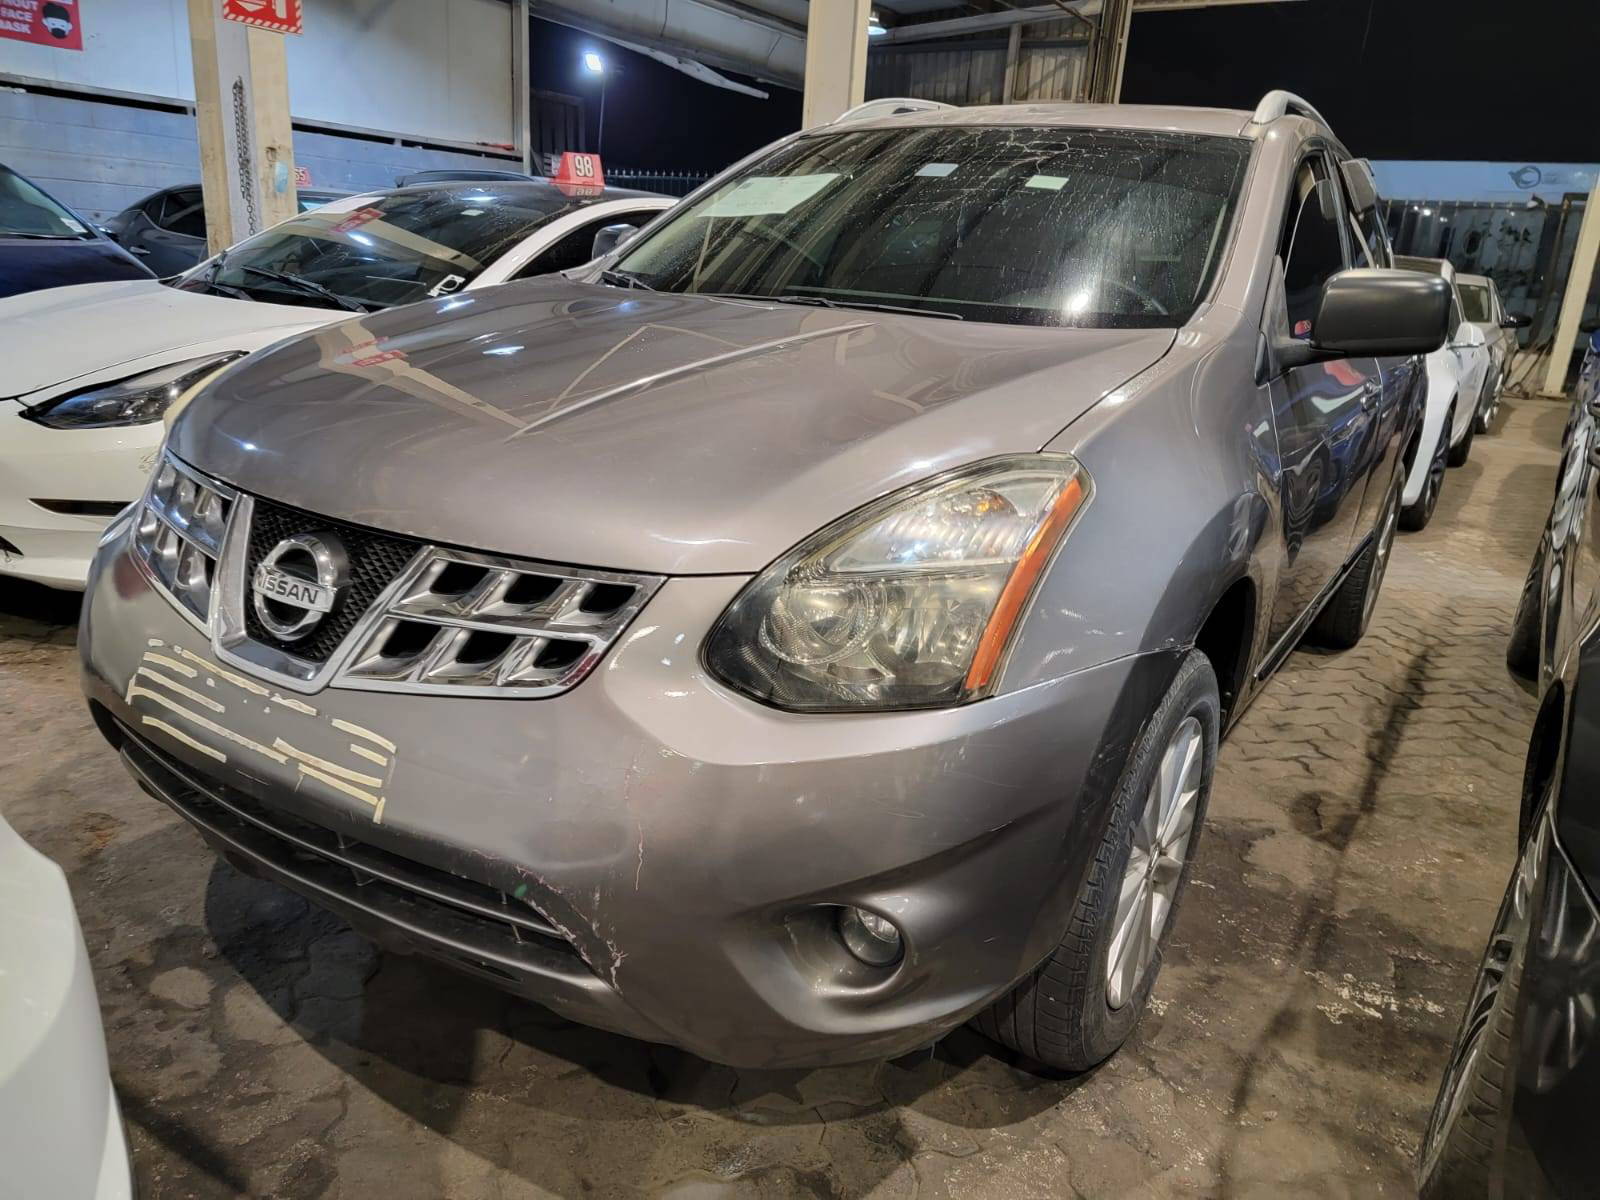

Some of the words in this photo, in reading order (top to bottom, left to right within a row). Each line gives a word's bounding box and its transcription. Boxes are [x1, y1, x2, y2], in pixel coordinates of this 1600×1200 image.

[0, 6, 33, 22] FACE
[575, 155, 593, 177] 98
[256, 569, 319, 604] NISSAN
